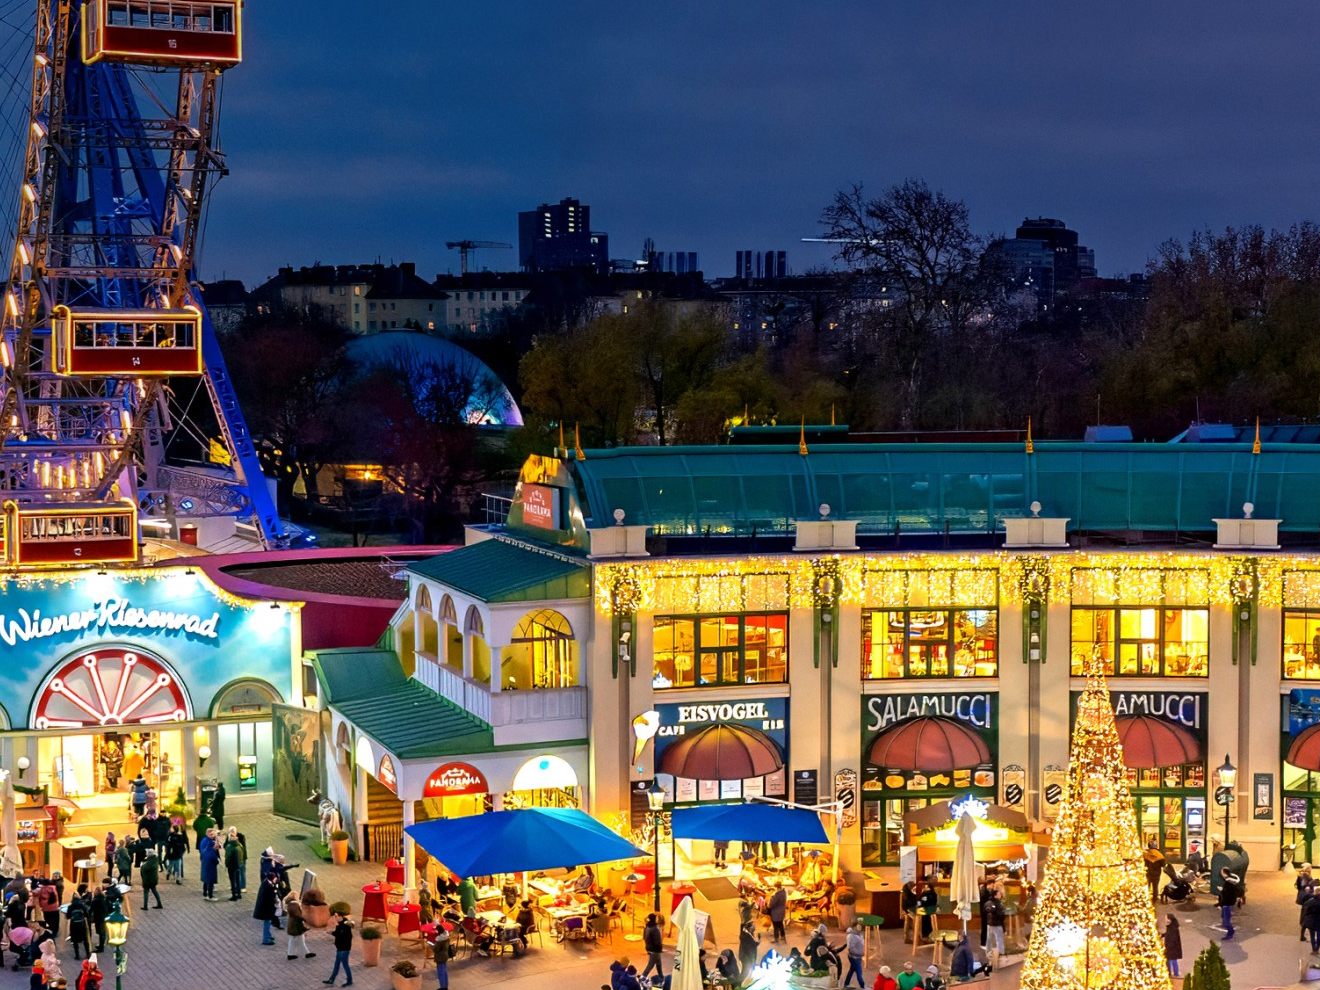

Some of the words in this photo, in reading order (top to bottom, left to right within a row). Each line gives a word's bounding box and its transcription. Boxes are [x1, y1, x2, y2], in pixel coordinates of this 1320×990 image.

[0, 607, 99, 646] Wiener
[95, 598, 220, 639] Riesenrad
[678, 703, 768, 722] EISVOGEL
[868, 694, 990, 731] SALAMUCCI
[1077, 693, 1200, 729] AMUCCI
[430, 776, 481, 788] PANORAMA
